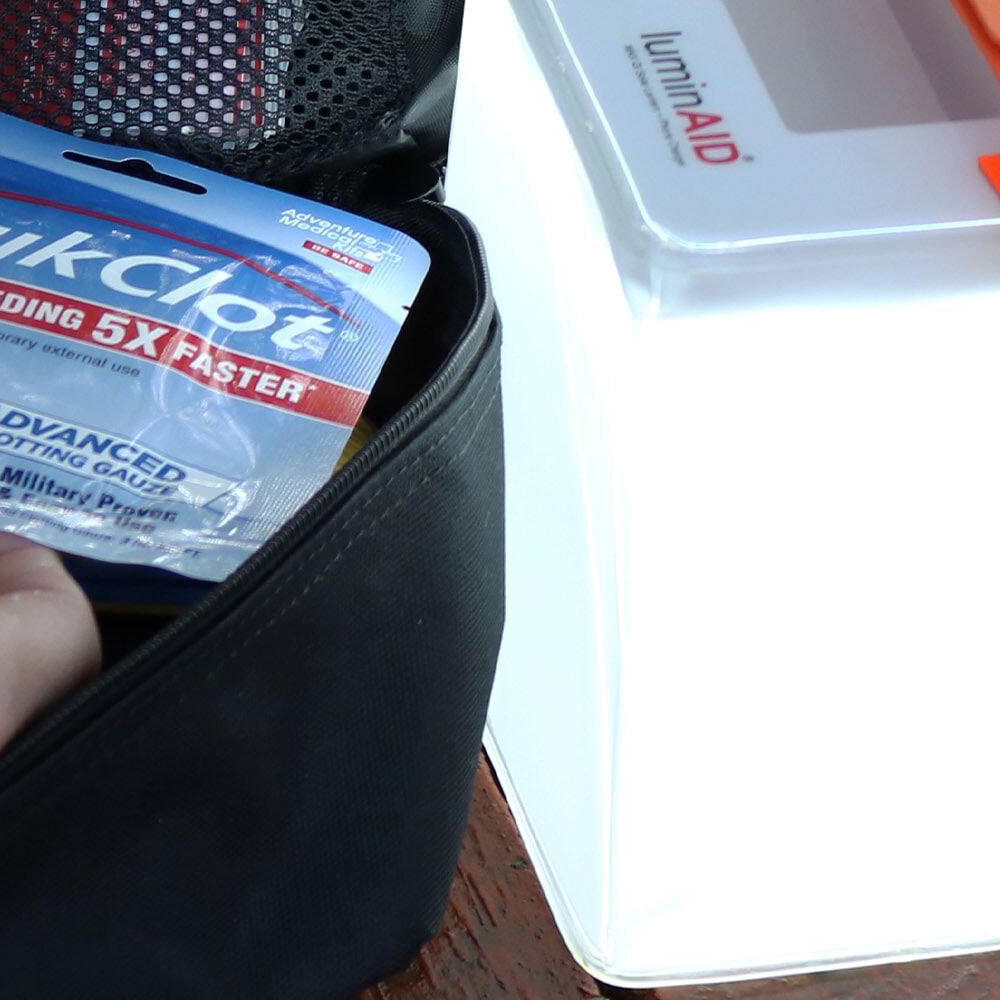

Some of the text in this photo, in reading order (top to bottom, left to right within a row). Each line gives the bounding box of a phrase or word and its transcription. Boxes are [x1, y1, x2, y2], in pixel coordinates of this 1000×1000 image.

[640, 31, 740, 165] luminAID
[278, 215, 358, 249] Medical
[280, 208, 381, 246] Adventure
[311, 243, 365, 270] BE SAFE
[91, 311, 170, 358] 5X
[41, 343, 109, 369] external
[111, 363, 142, 378] use
[0, 465, 91, 506] Military
[96, 492, 178, 522] Proven
